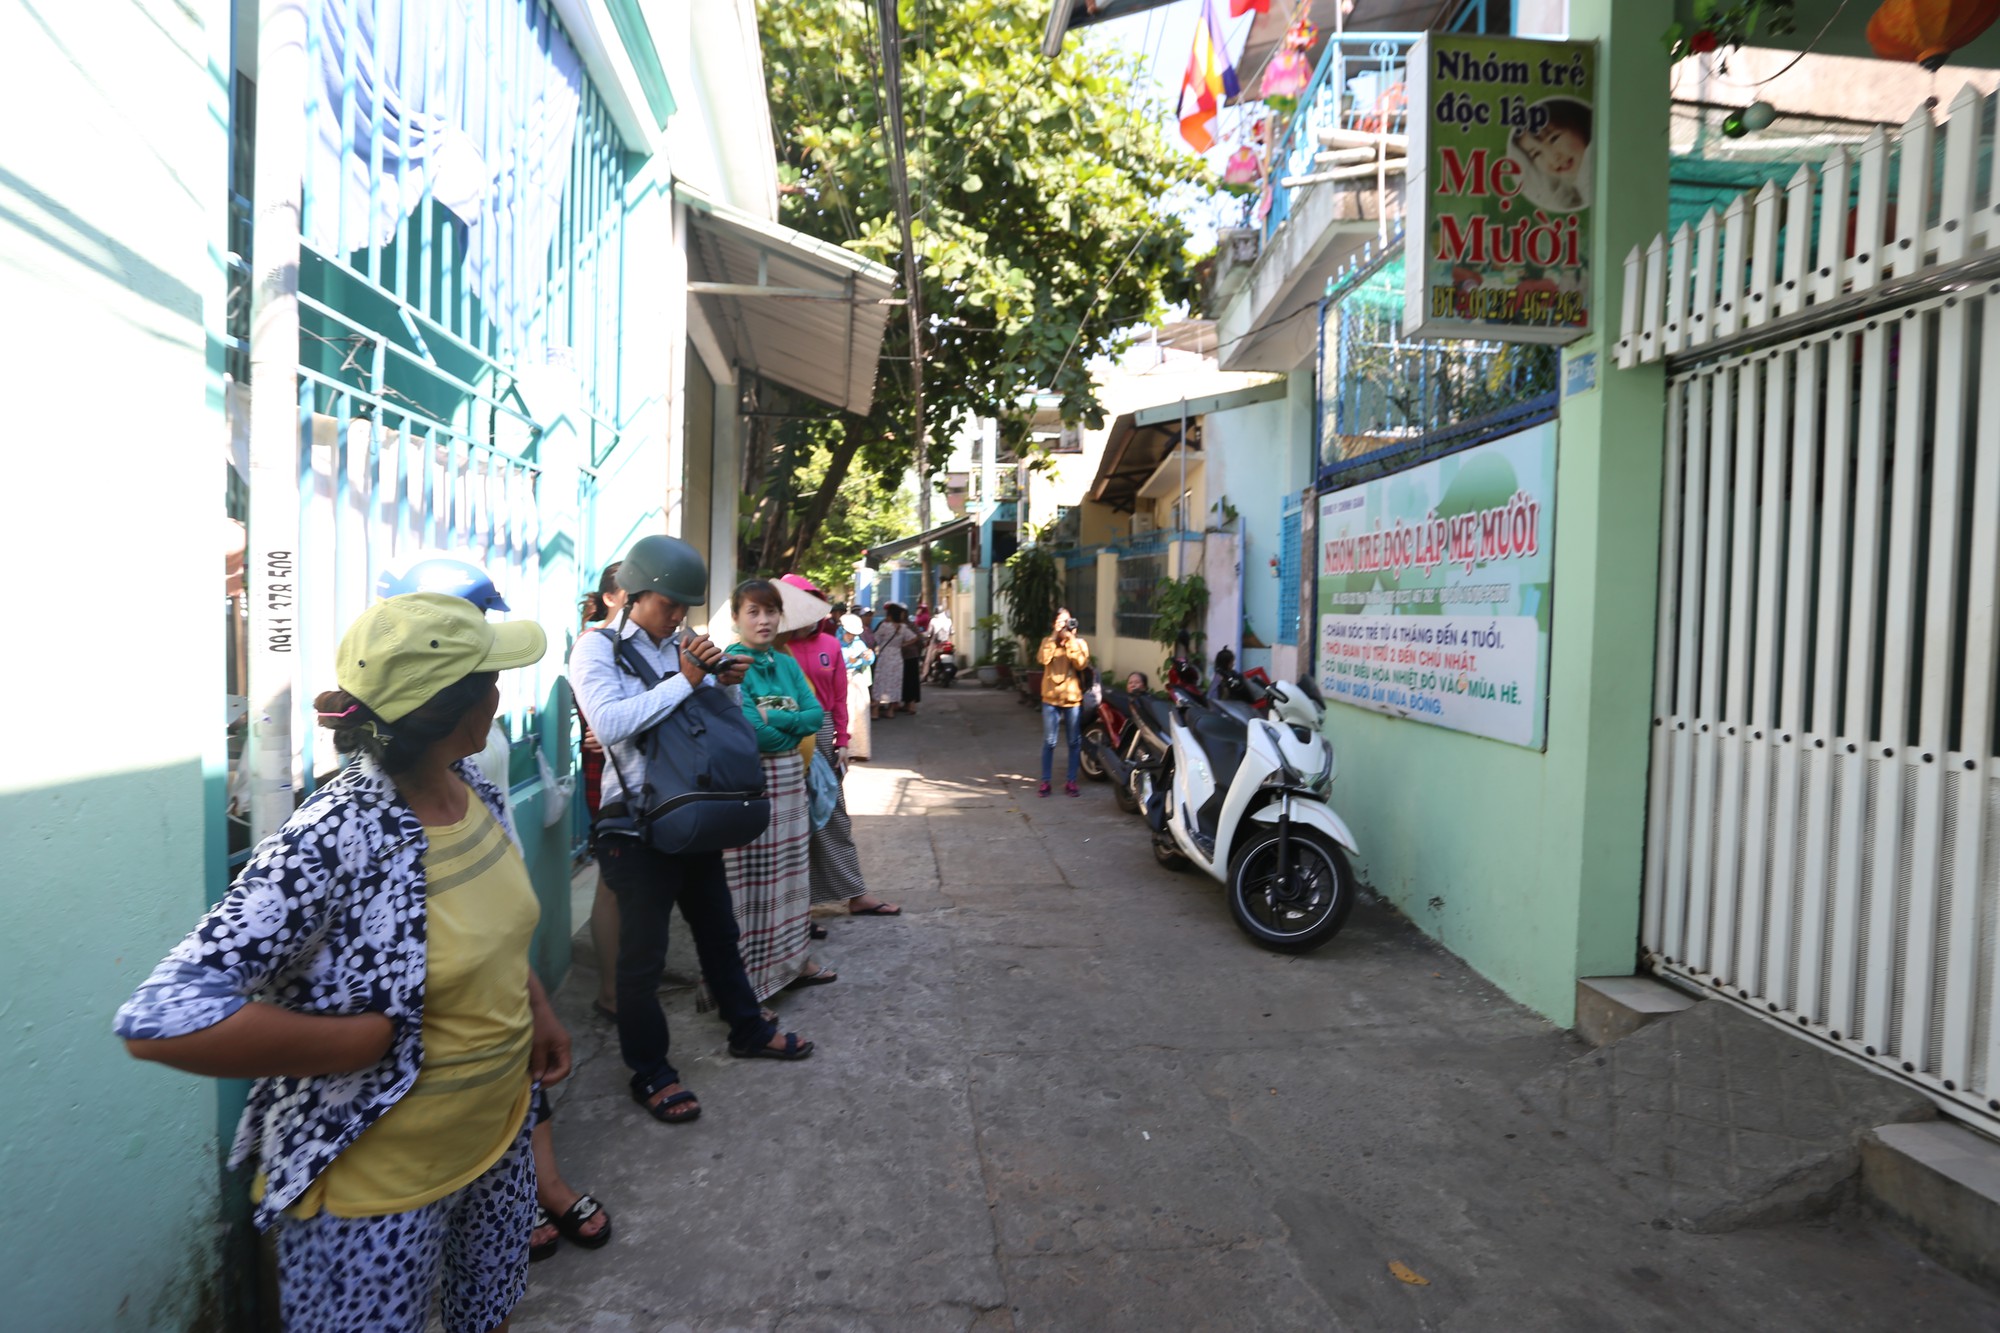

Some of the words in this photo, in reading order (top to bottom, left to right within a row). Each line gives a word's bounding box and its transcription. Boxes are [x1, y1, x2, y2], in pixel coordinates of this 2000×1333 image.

[1436, 51, 1530, 85] Nhóm
[1539, 53, 1585, 87] trẻ
[1436, 92, 1489, 133] độc
[1500, 97, 1549, 134] lập
[1436, 147, 1524, 211] Mẹ
[1436, 210, 1581, 266] Mười
[1469, 287, 1517, 320] 01237
[1521, 290, 1551, 321] 467
[1553, 290, 1584, 322] 262
[1324, 528, 1355, 574] NHÓM
[1357, 517, 1381, 572] TRẺ
[1382, 515, 1413, 580] ĐỘC
[1414, 511, 1448, 578] LẬP
[1449, 511, 1477, 576] MẸ
[1479, 490, 1540, 560] MƯỜI
[1392, 627, 1398, 640] 4
[1400, 623, 1433, 643] THÁNG
[1436, 622, 1457, 645] ĐẾN
[1461, 630, 1468, 646] 4
[1471, 621, 1504, 649] TUỔI.
[1390, 648, 1396, 662] 2
[1398, 643, 1416, 664] ĐẾN
[1419, 647, 1440, 668] CHỦ
[1421, 670, 1436, 695] ĐỘ
[1467, 677, 1496, 700] MÙA
